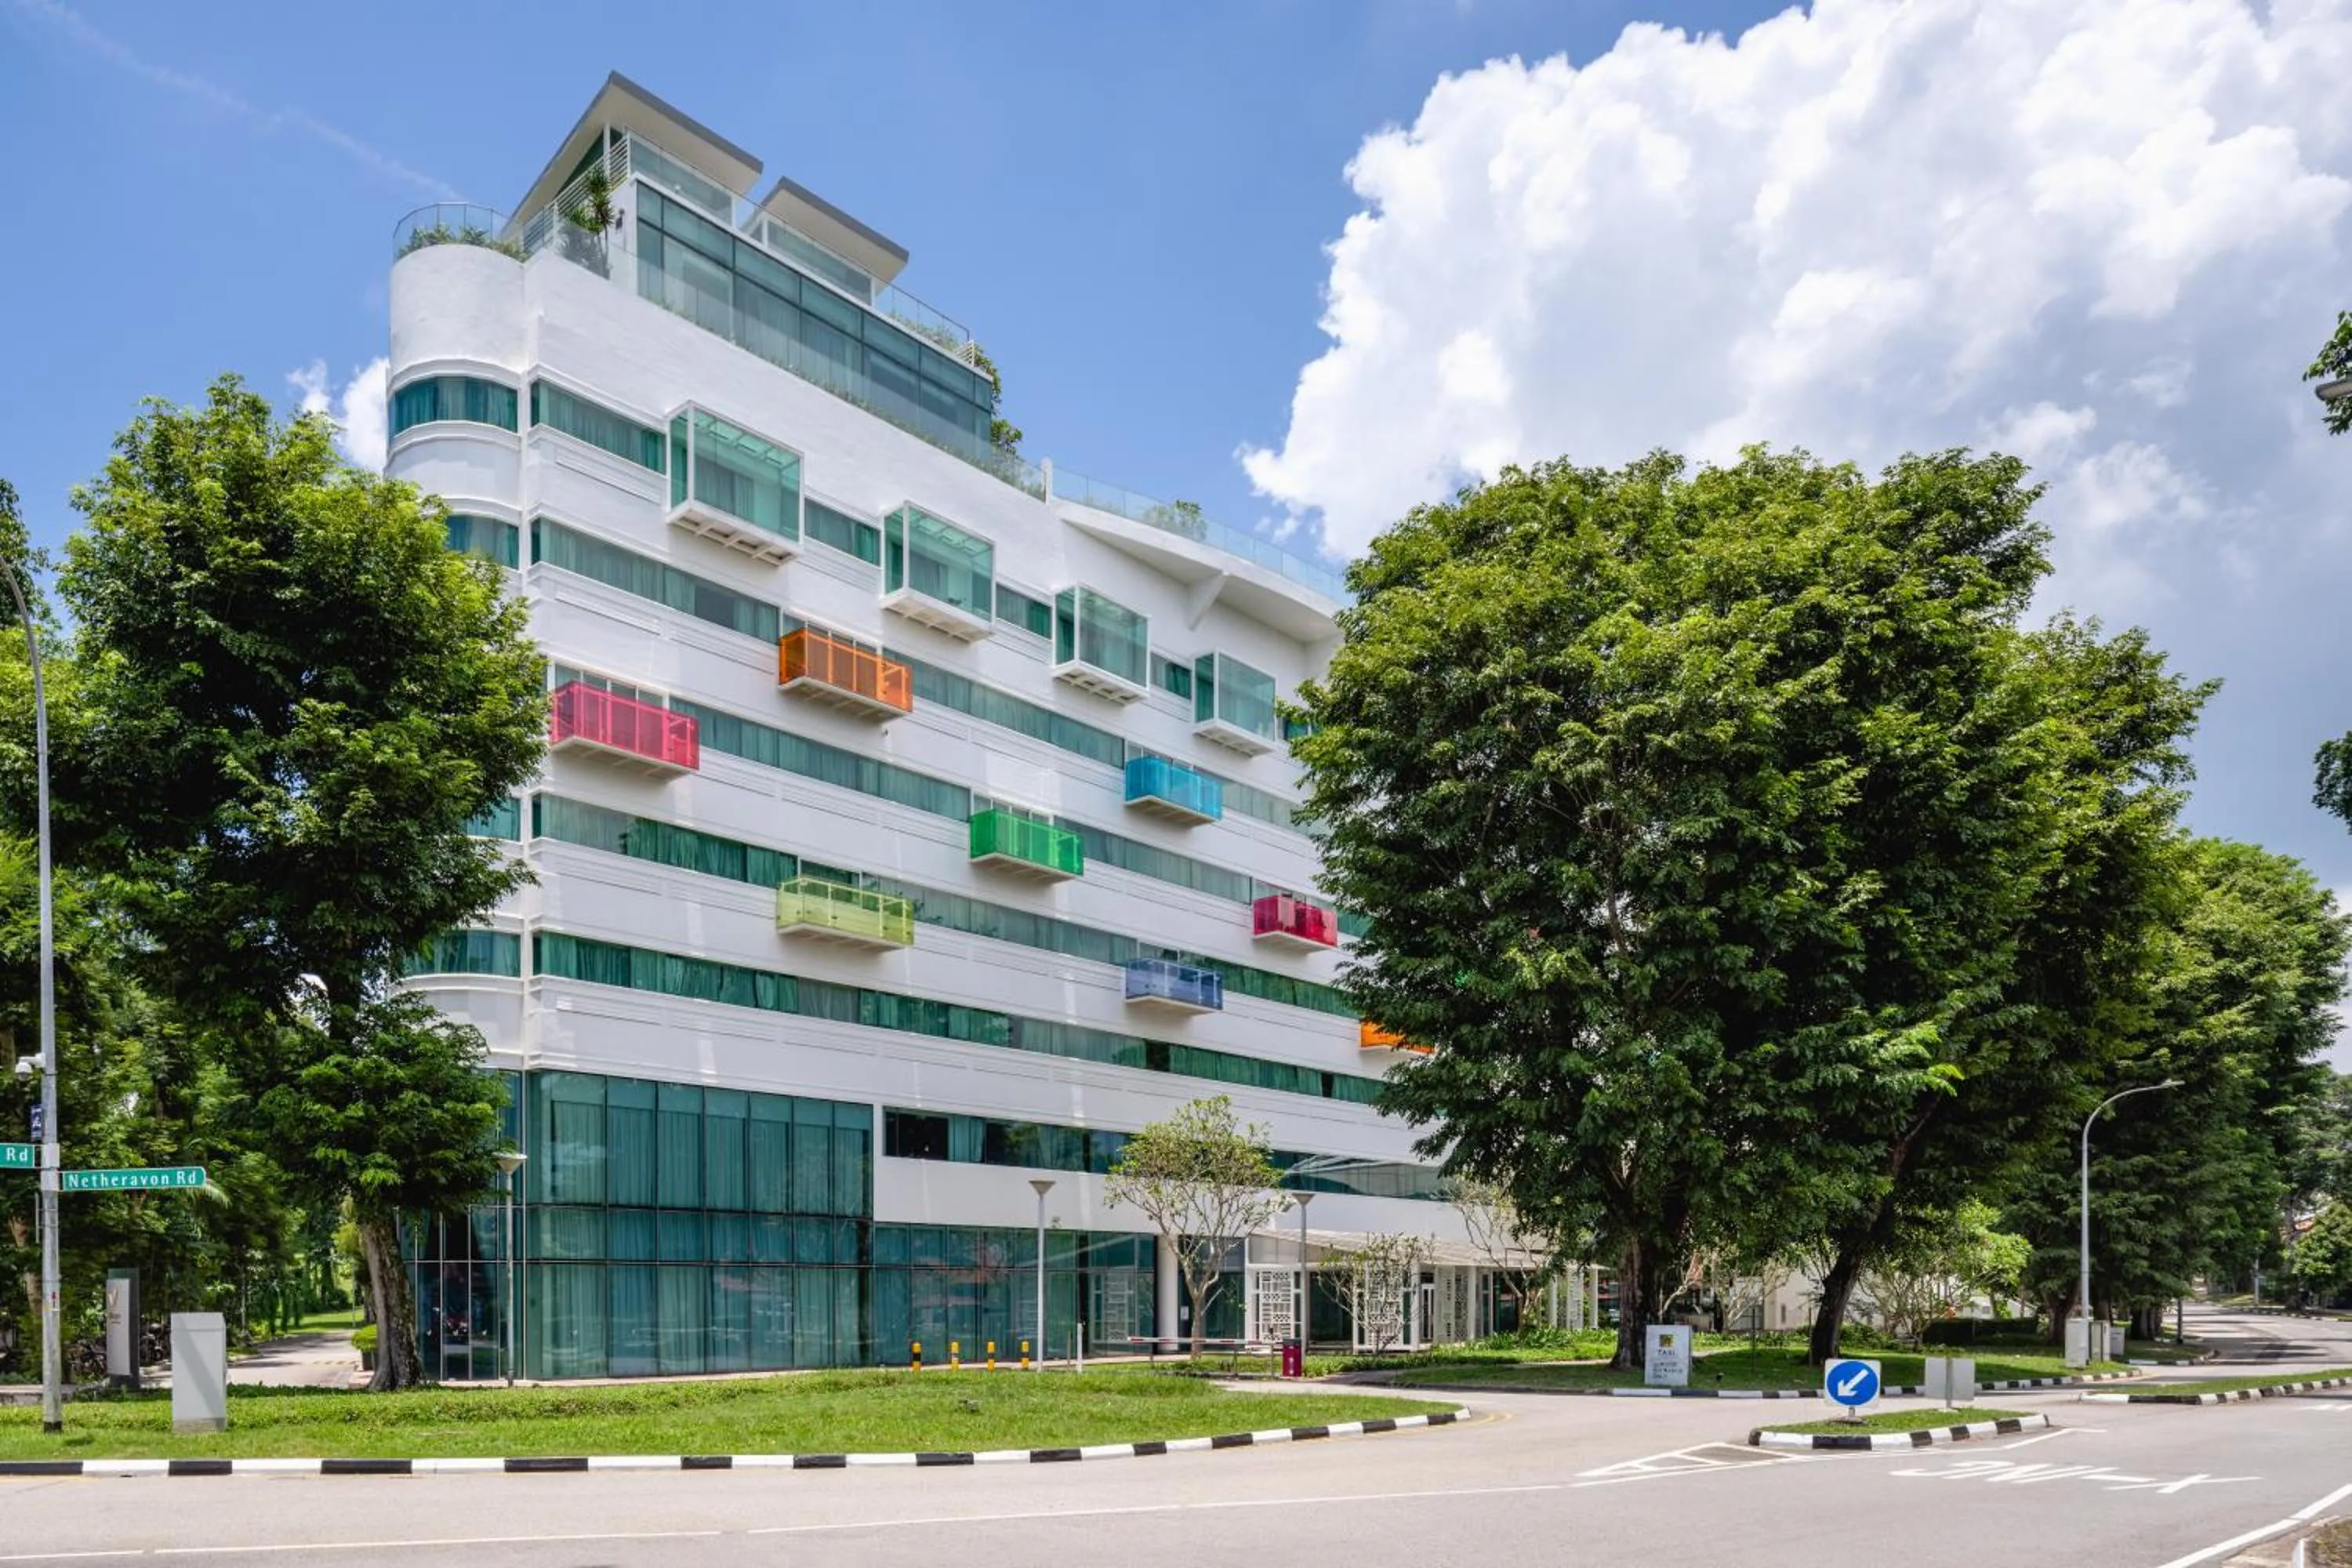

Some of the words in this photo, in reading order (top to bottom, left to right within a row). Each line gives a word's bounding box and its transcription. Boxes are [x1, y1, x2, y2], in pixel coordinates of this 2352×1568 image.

[6, 1148, 28, 1161] Rd
[68, 1171, 169, 1189] Netheravon
[176, 1171, 196, 1185] Rd
